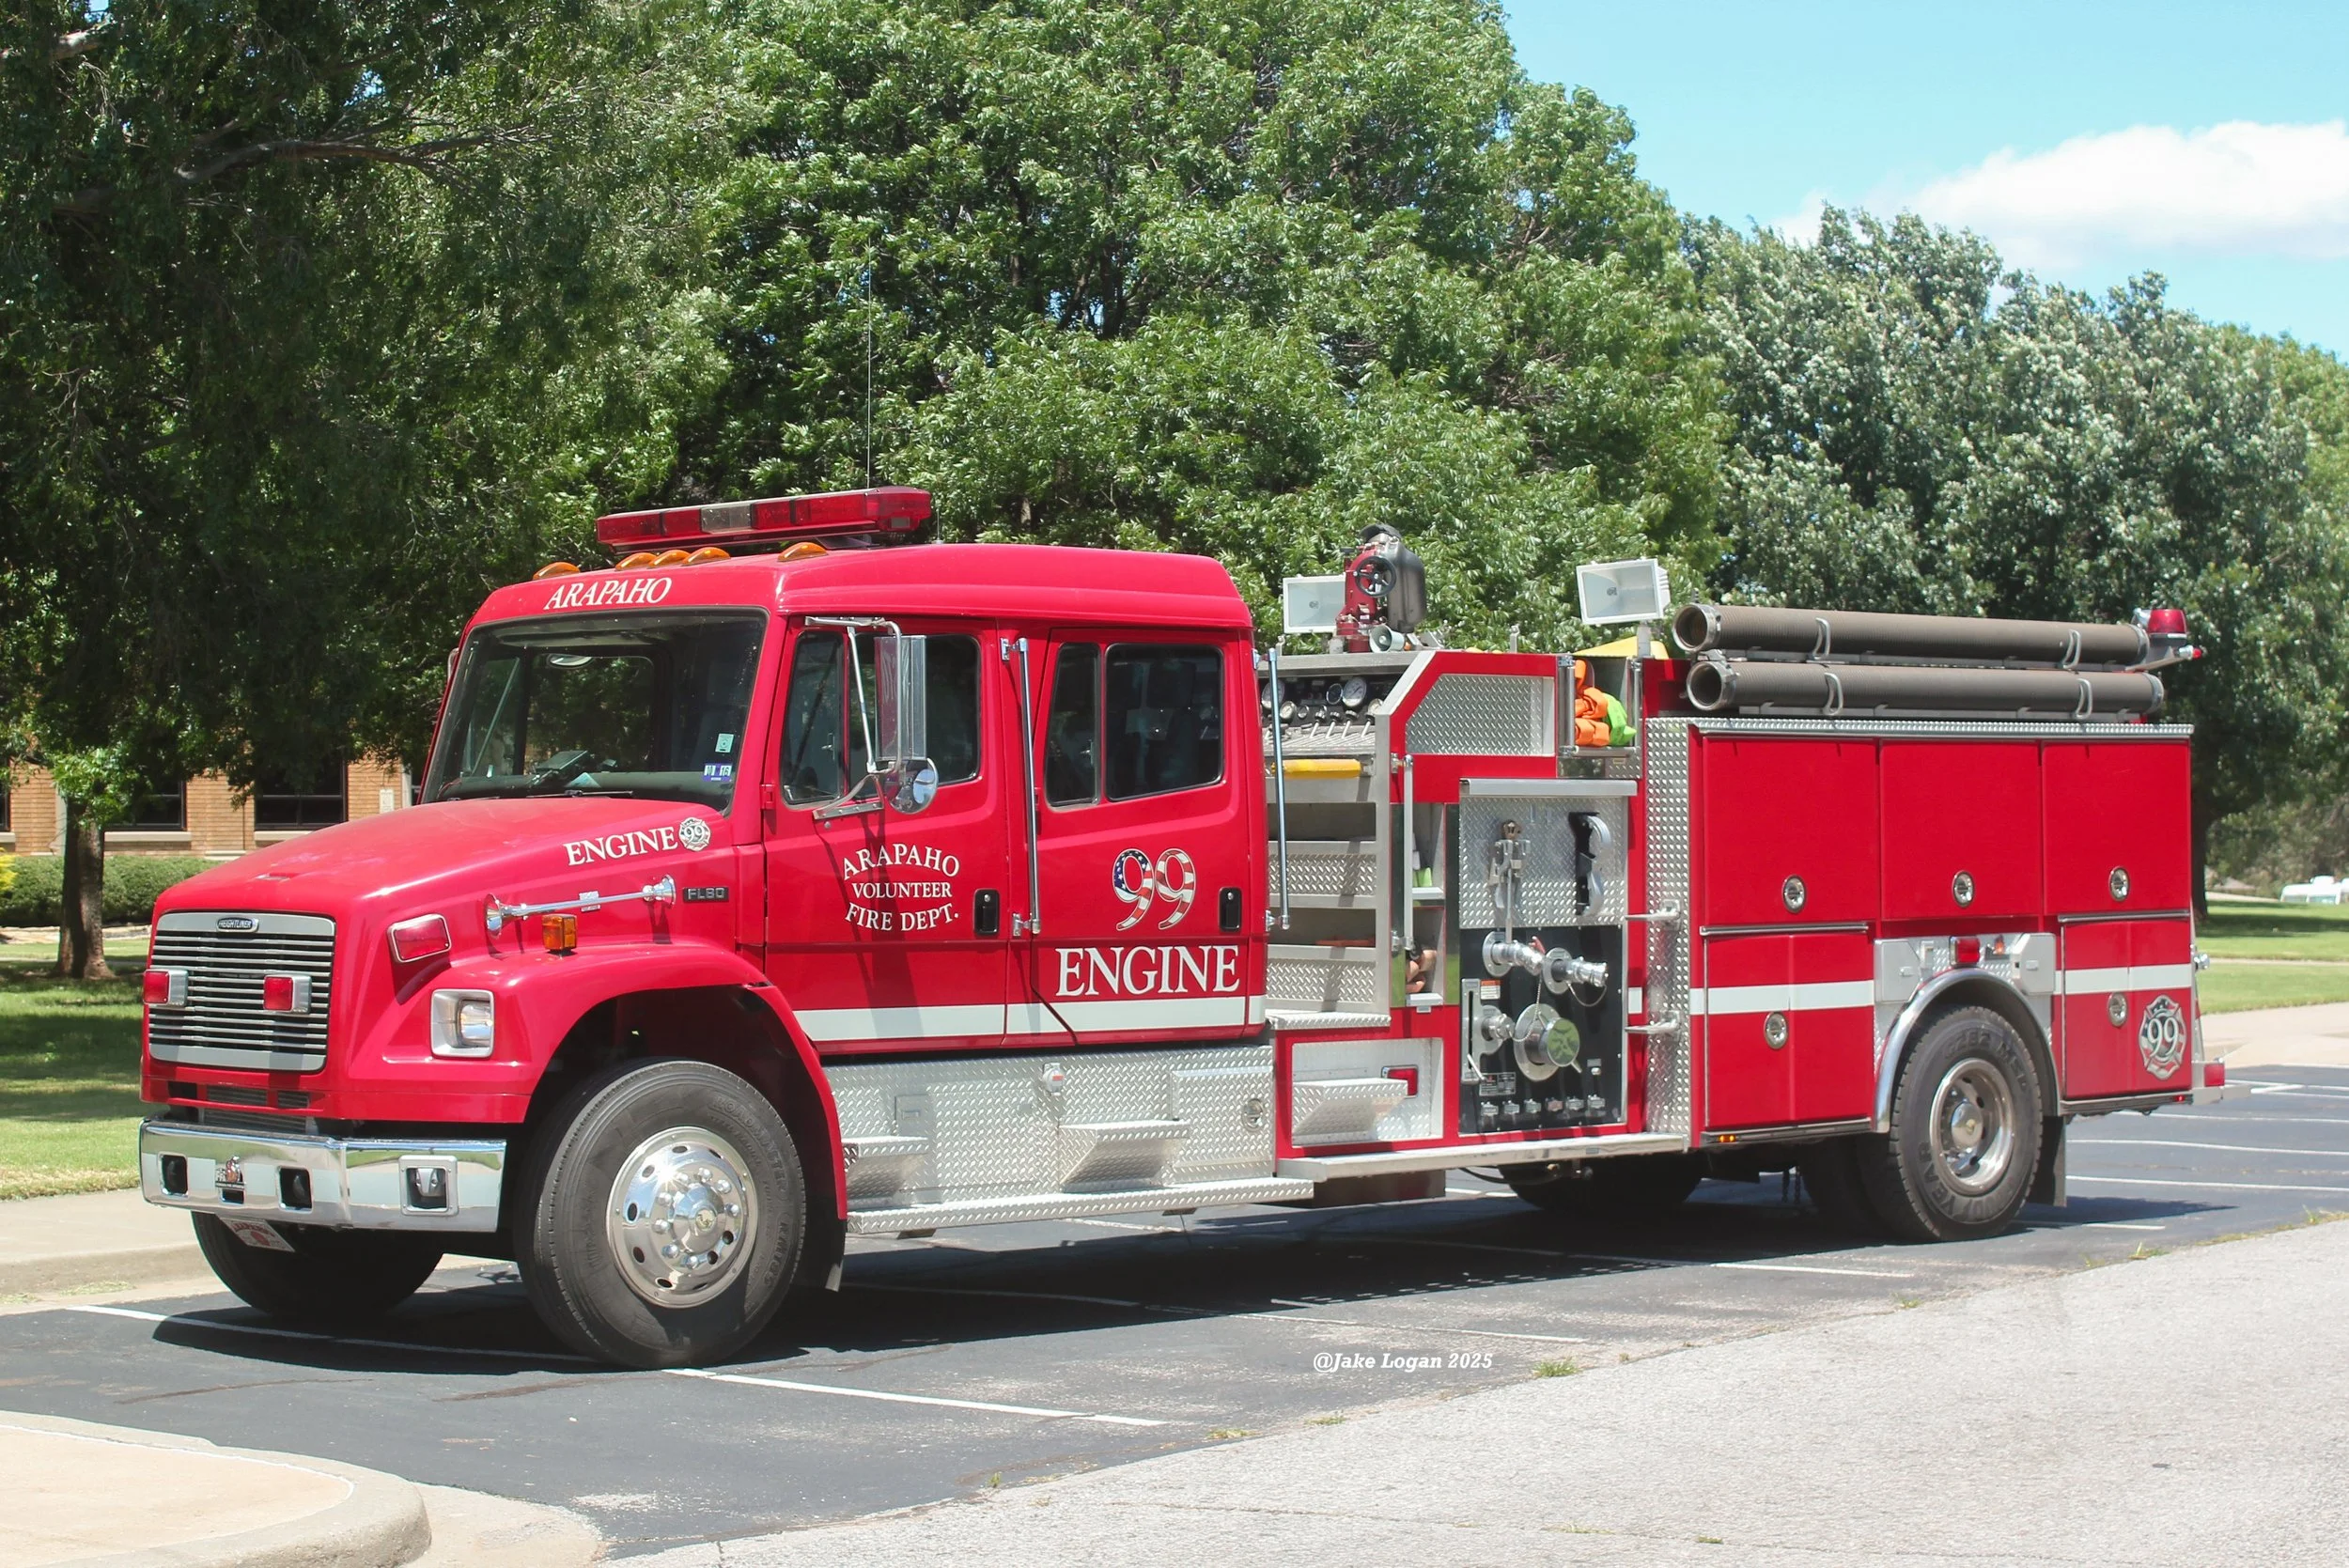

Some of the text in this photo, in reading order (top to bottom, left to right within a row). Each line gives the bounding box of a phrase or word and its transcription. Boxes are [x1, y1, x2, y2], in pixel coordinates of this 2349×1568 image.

[543, 577, 673, 611] ARAPAHO
[563, 826, 678, 866] ENGINE
[683, 825, 707, 845] 99
[843, 843, 960, 881] ARAPAHO
[687, 887, 725, 900] FL80
[851, 881, 953, 899] VOLUNTEER
[1112, 847, 1196, 931] 99
[844, 902, 959, 932] FIRE DEPT.
[1055, 945, 1240, 997] ENGINE
[2147, 1017, 2180, 1058] 99
